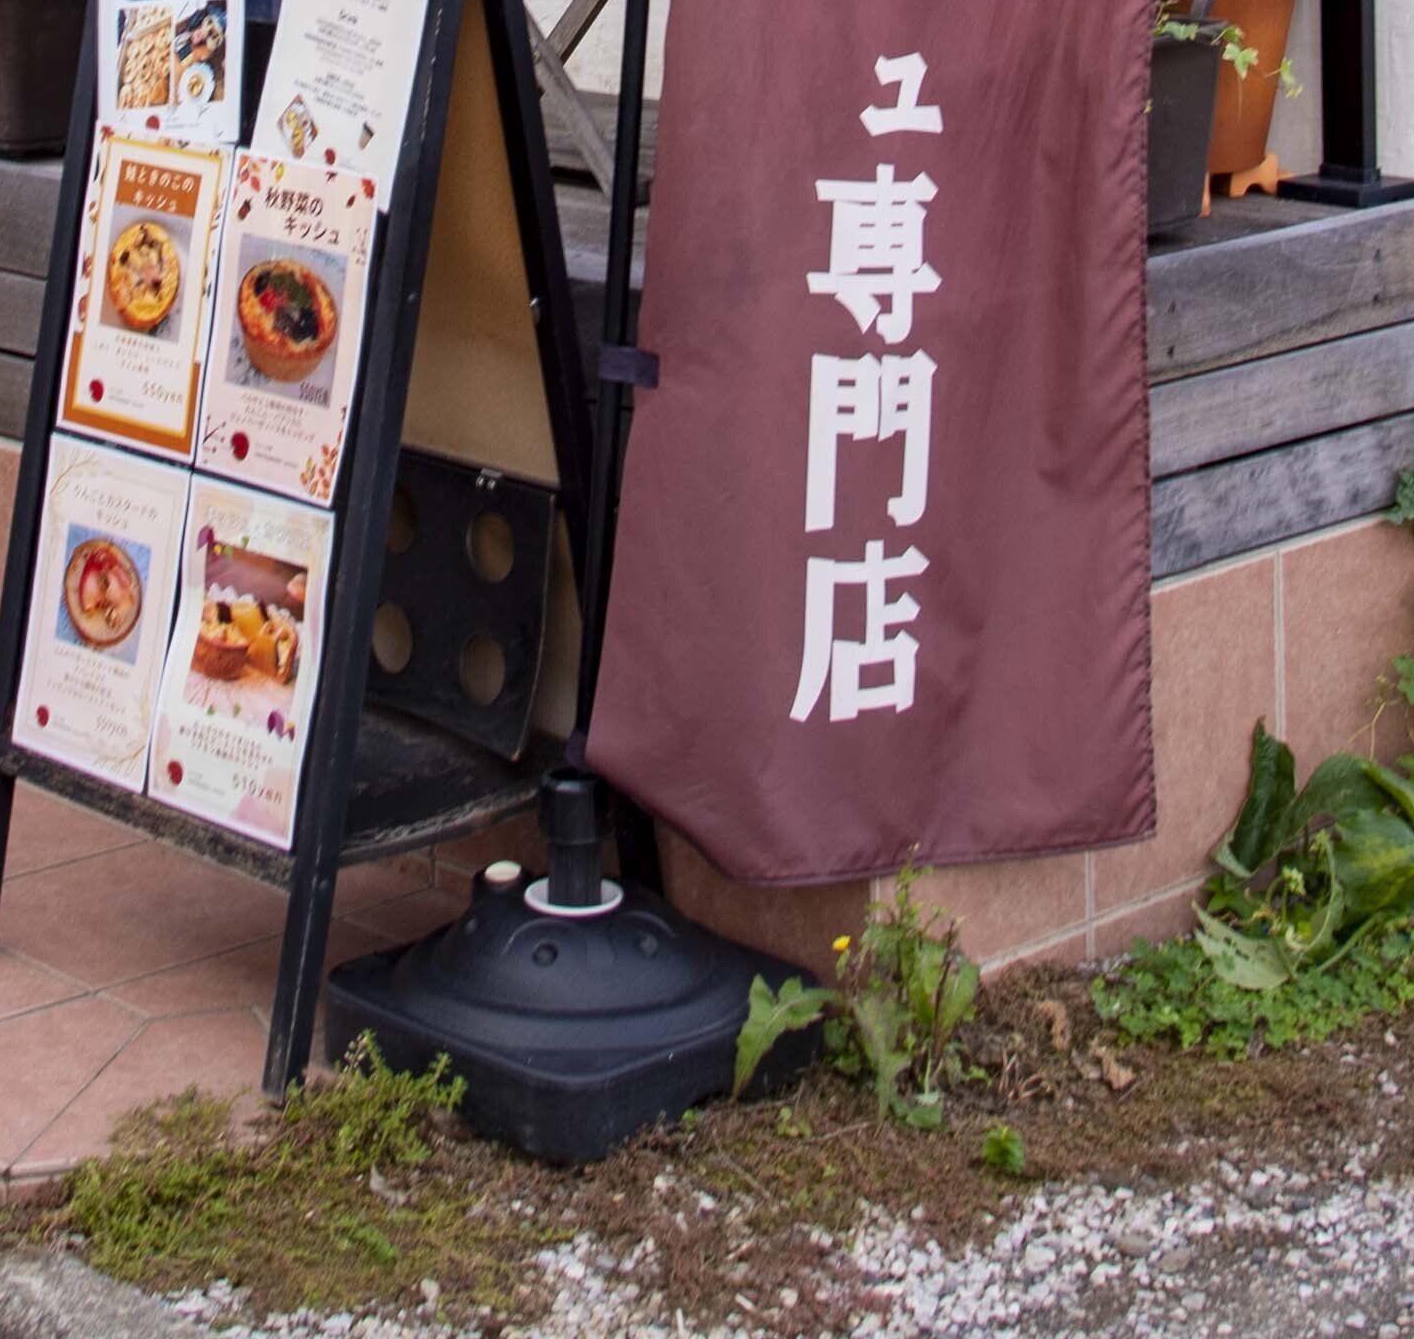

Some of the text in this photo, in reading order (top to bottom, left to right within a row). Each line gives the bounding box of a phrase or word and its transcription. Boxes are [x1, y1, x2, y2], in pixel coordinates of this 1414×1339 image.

[132, 189, 177, 213] キッシュ
[284, 215, 341, 245] キッシュ
